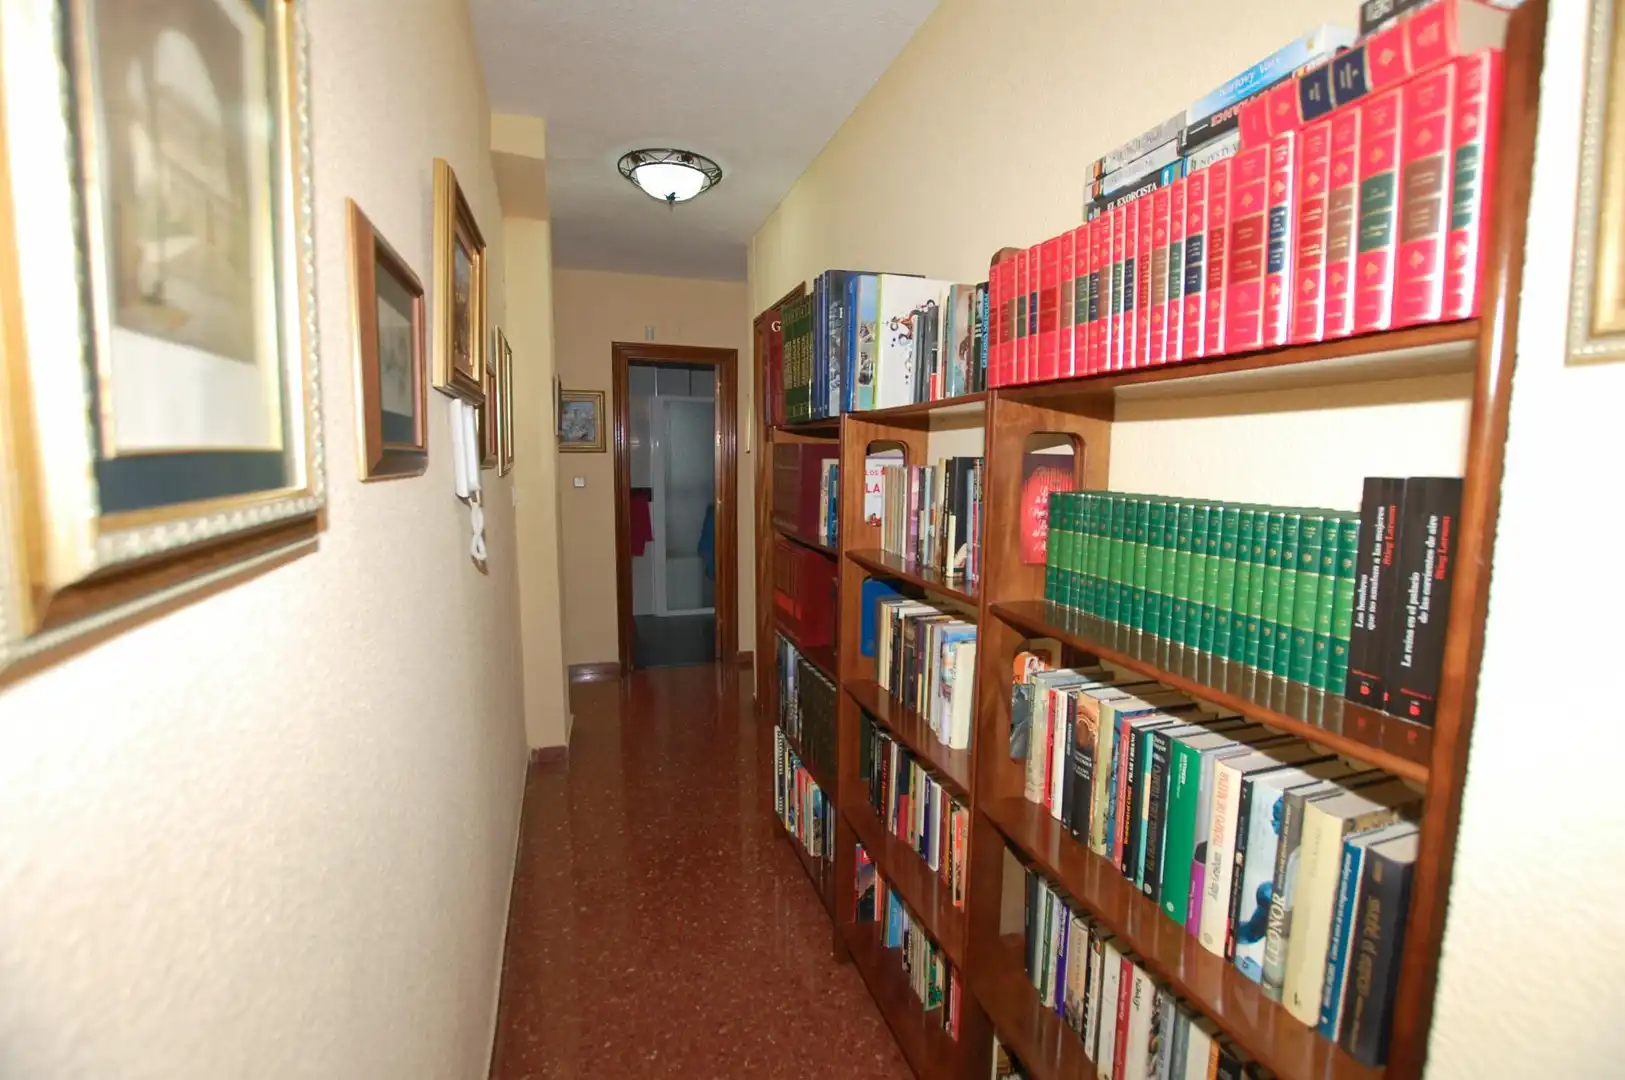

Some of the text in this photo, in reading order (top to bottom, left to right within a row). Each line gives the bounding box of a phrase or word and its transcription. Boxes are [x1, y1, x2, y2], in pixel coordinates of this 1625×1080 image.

[1117, 183, 1157, 207] EXORCISTA
[865, 482, 881, 493] LA
[1408, 572, 1420, 605] palacio
[1403, 629, 1414, 654] reina
[1401, 655, 1412, 667] La
[1265, 891, 1285, 968] LEONOR
